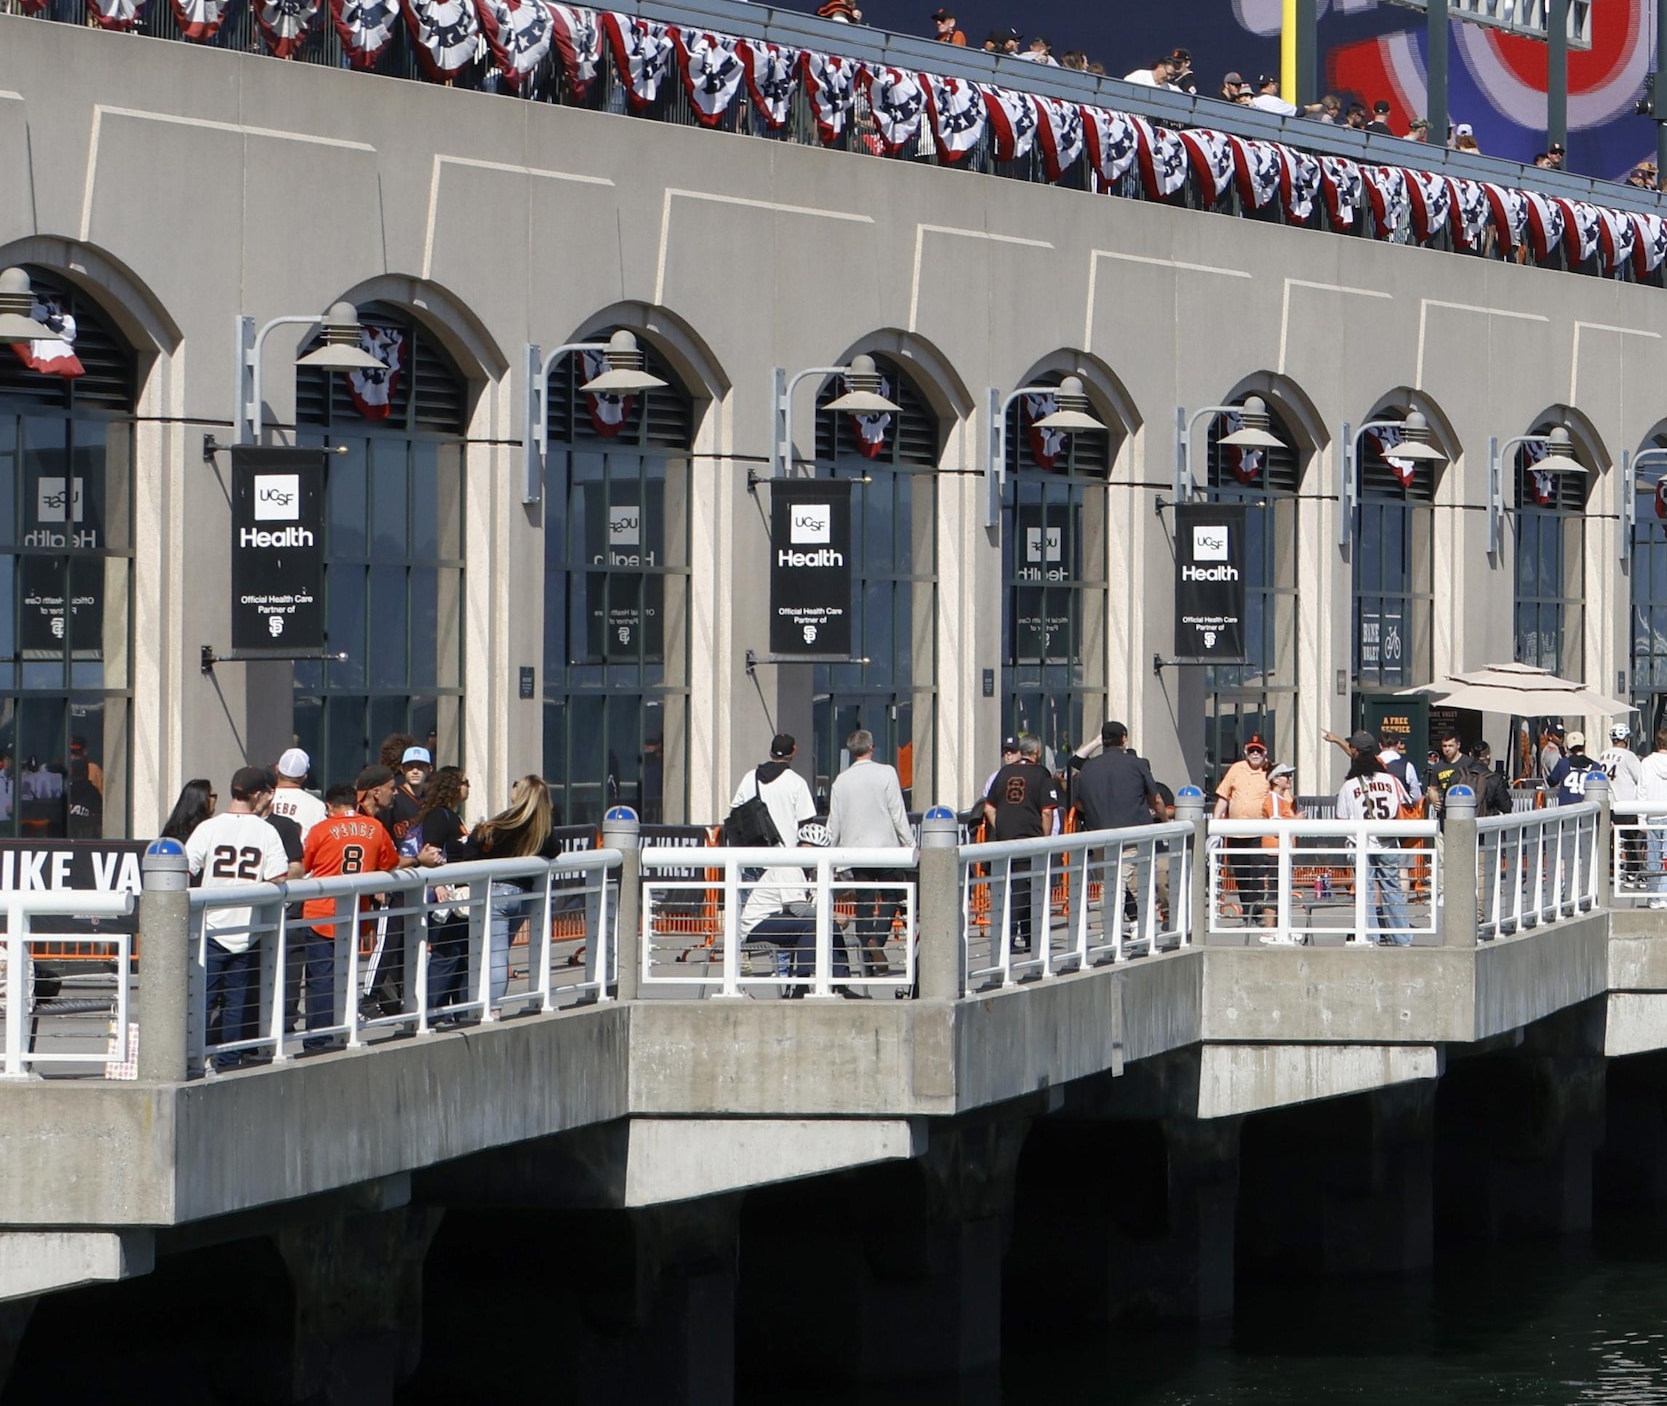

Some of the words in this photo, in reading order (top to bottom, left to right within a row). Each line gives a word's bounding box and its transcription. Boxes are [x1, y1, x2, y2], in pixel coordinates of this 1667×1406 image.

[260, 489, 293, 506] UCSF
[795, 516, 826, 532] UCSF
[240, 527, 313, 547] Health
[1197, 537, 1223, 550] UCSF
[778, 549, 843, 567] Health
[1182, 565, 1238, 581] Health
[269, 595, 293, 603] Health
[295, 594, 313, 603] Care
[803, 607, 825, 615] Health
[826, 607, 843, 615] Care
[1390, 716, 1408, 725] FREE
[1006, 777, 1026, 804] 8
[275, 803, 298, 816] EBB
[1362, 797, 1390, 820] 25
[330, 822, 376, 840] PENCE
[212, 844, 262, 882] 22
[342, 844, 363, 875] 8
